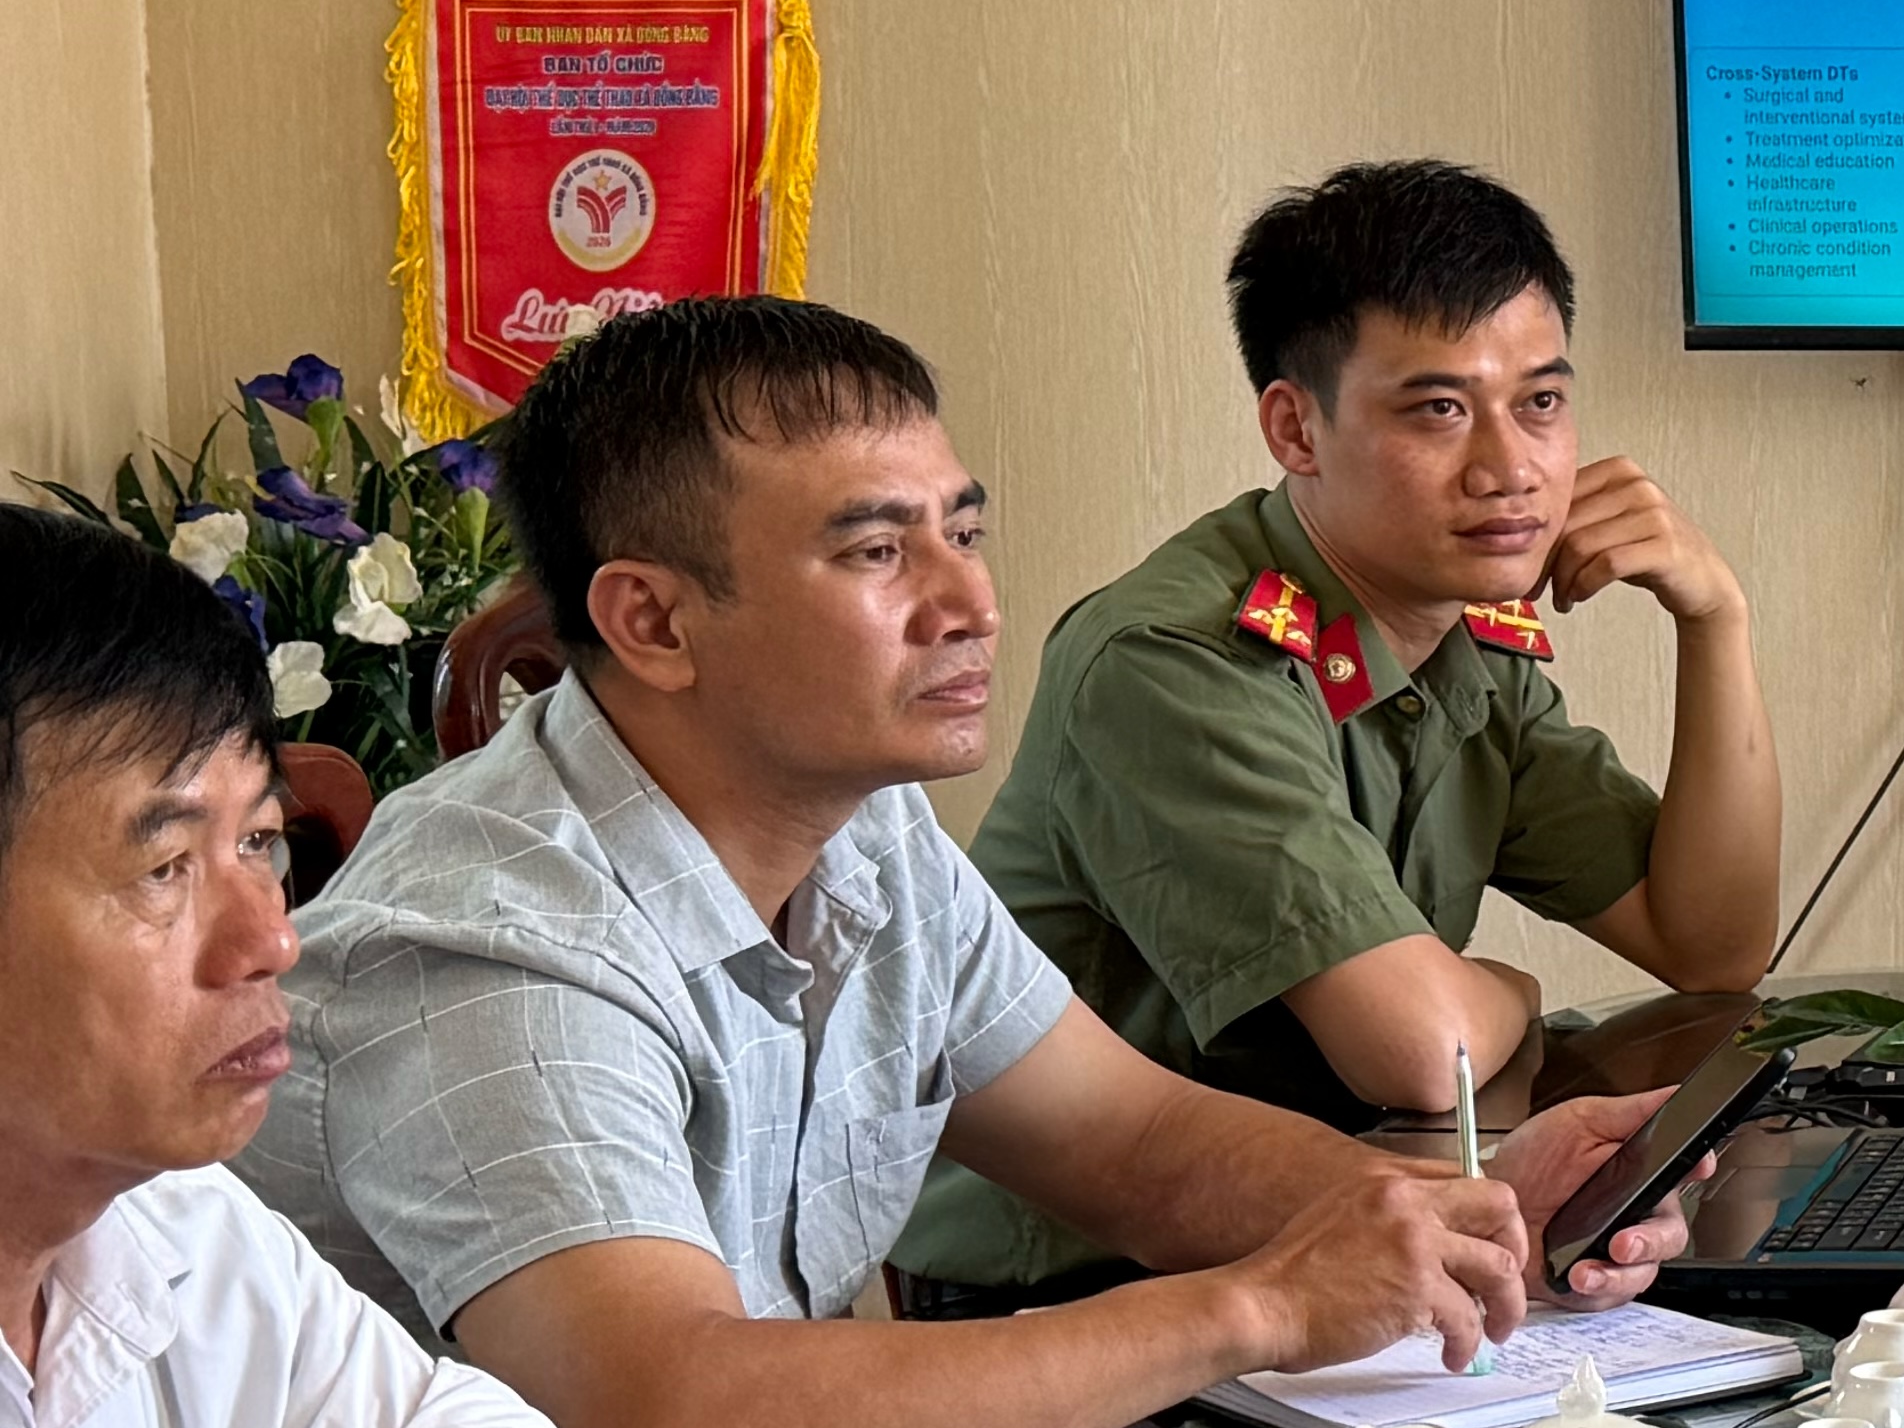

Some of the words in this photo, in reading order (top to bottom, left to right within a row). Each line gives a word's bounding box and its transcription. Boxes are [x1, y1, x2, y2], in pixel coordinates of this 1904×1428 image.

[1706, 65, 1823, 85] Cross-System
[1827, 65, 1859, 82] DTs
[1745, 152, 1811, 169] Medical
[1814, 152, 1895, 169] education
[1747, 174, 1836, 190] Healthcare
